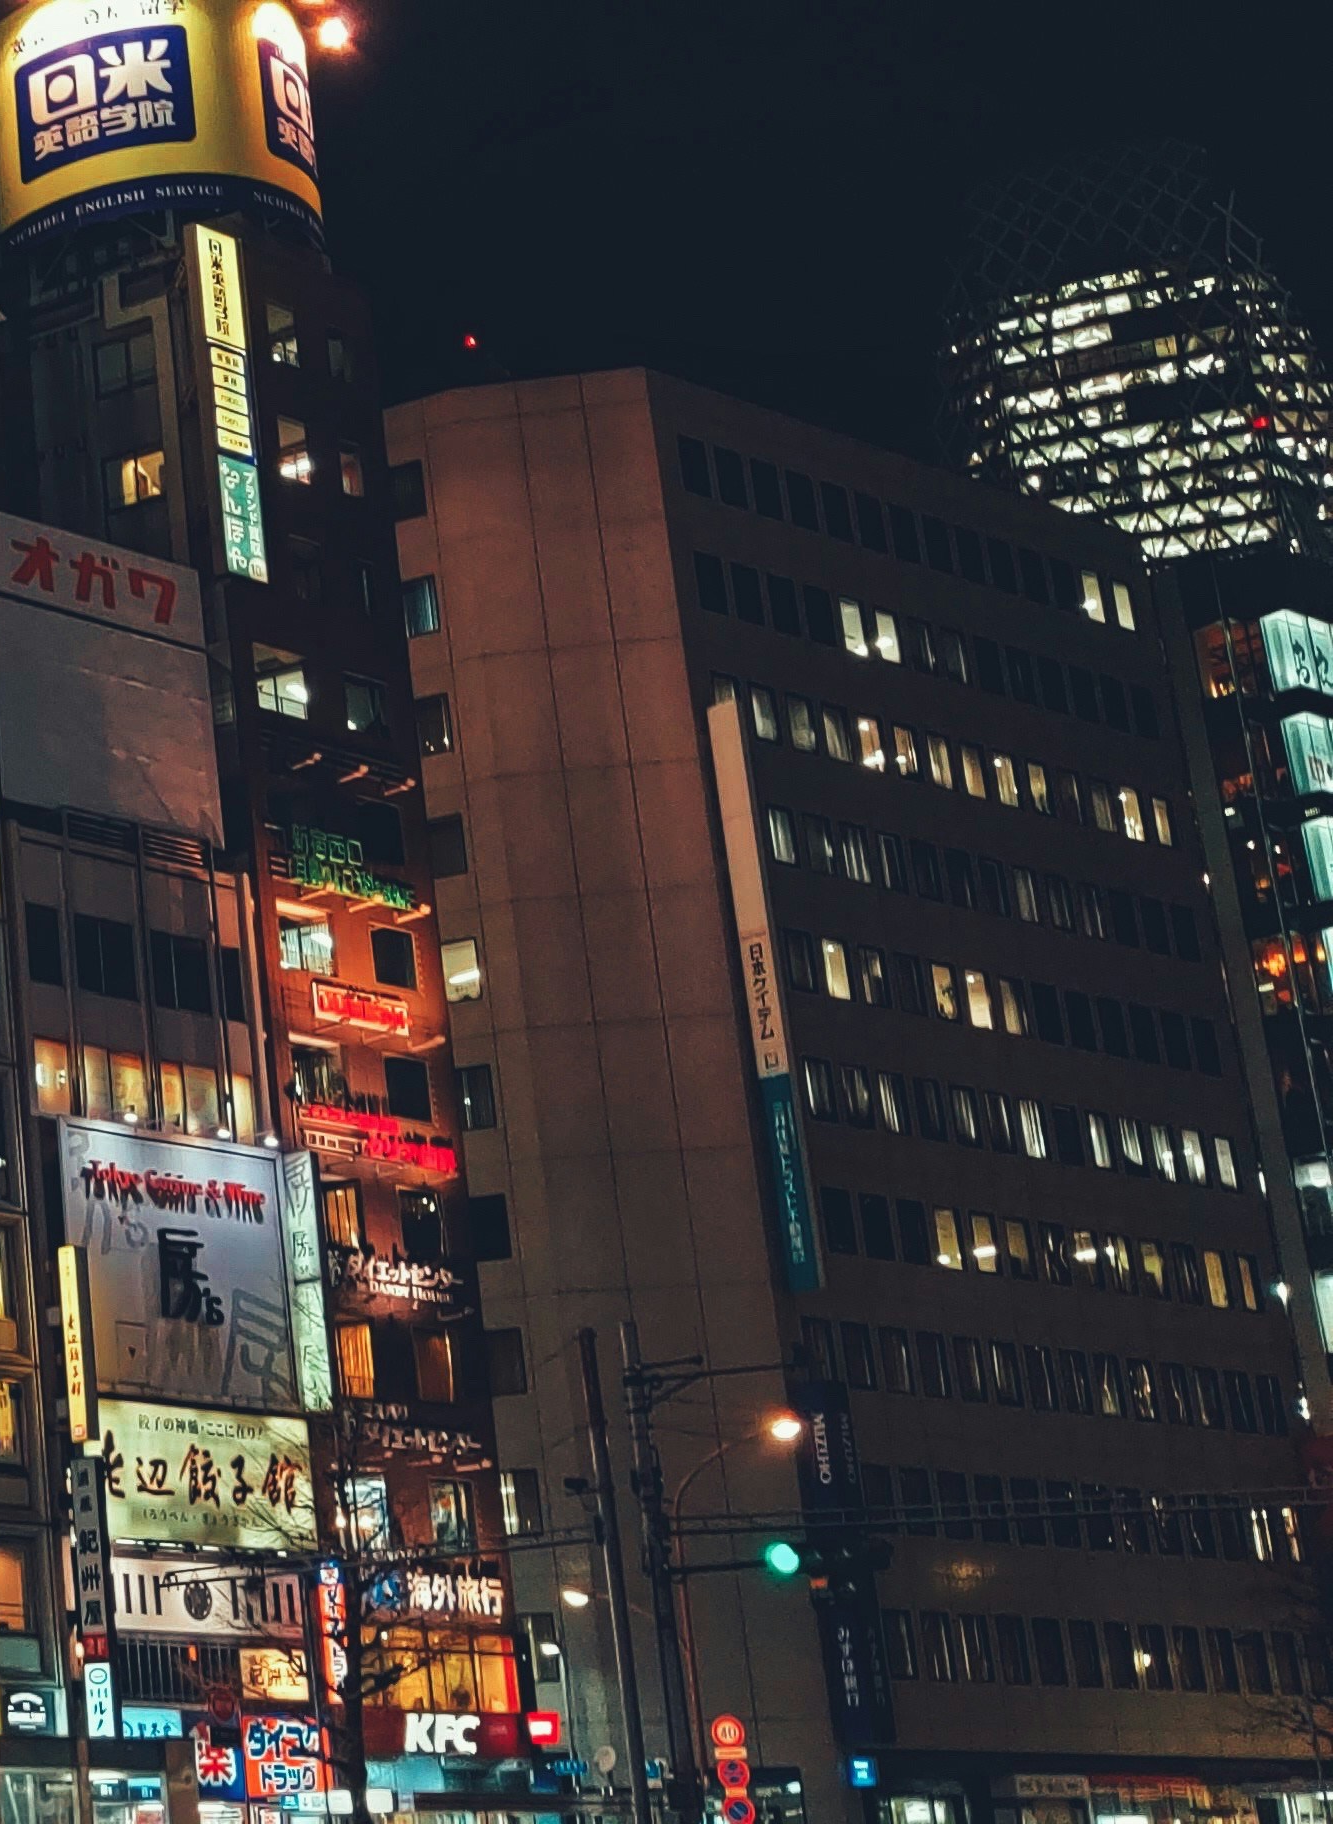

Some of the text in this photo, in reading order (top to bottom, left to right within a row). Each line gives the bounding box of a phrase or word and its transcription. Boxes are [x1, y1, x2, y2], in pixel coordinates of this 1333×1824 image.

[28, 39, 173, 125] 日米
[35, 99, 176, 162] 英語学院
[75, 190, 145, 217] ENGLISH
[155, 185, 224, 198] SERVICE
[10, 534, 178, 625] オガワ
[814, 1412, 832, 1484] MIZUHO
[407, 1572, 504, 1617] 海外旅行
[405, 1713, 480, 1755] KFC
[721, 1727, 736, 1740] 40
[259, 1763, 317, 1792] ドラッグ
